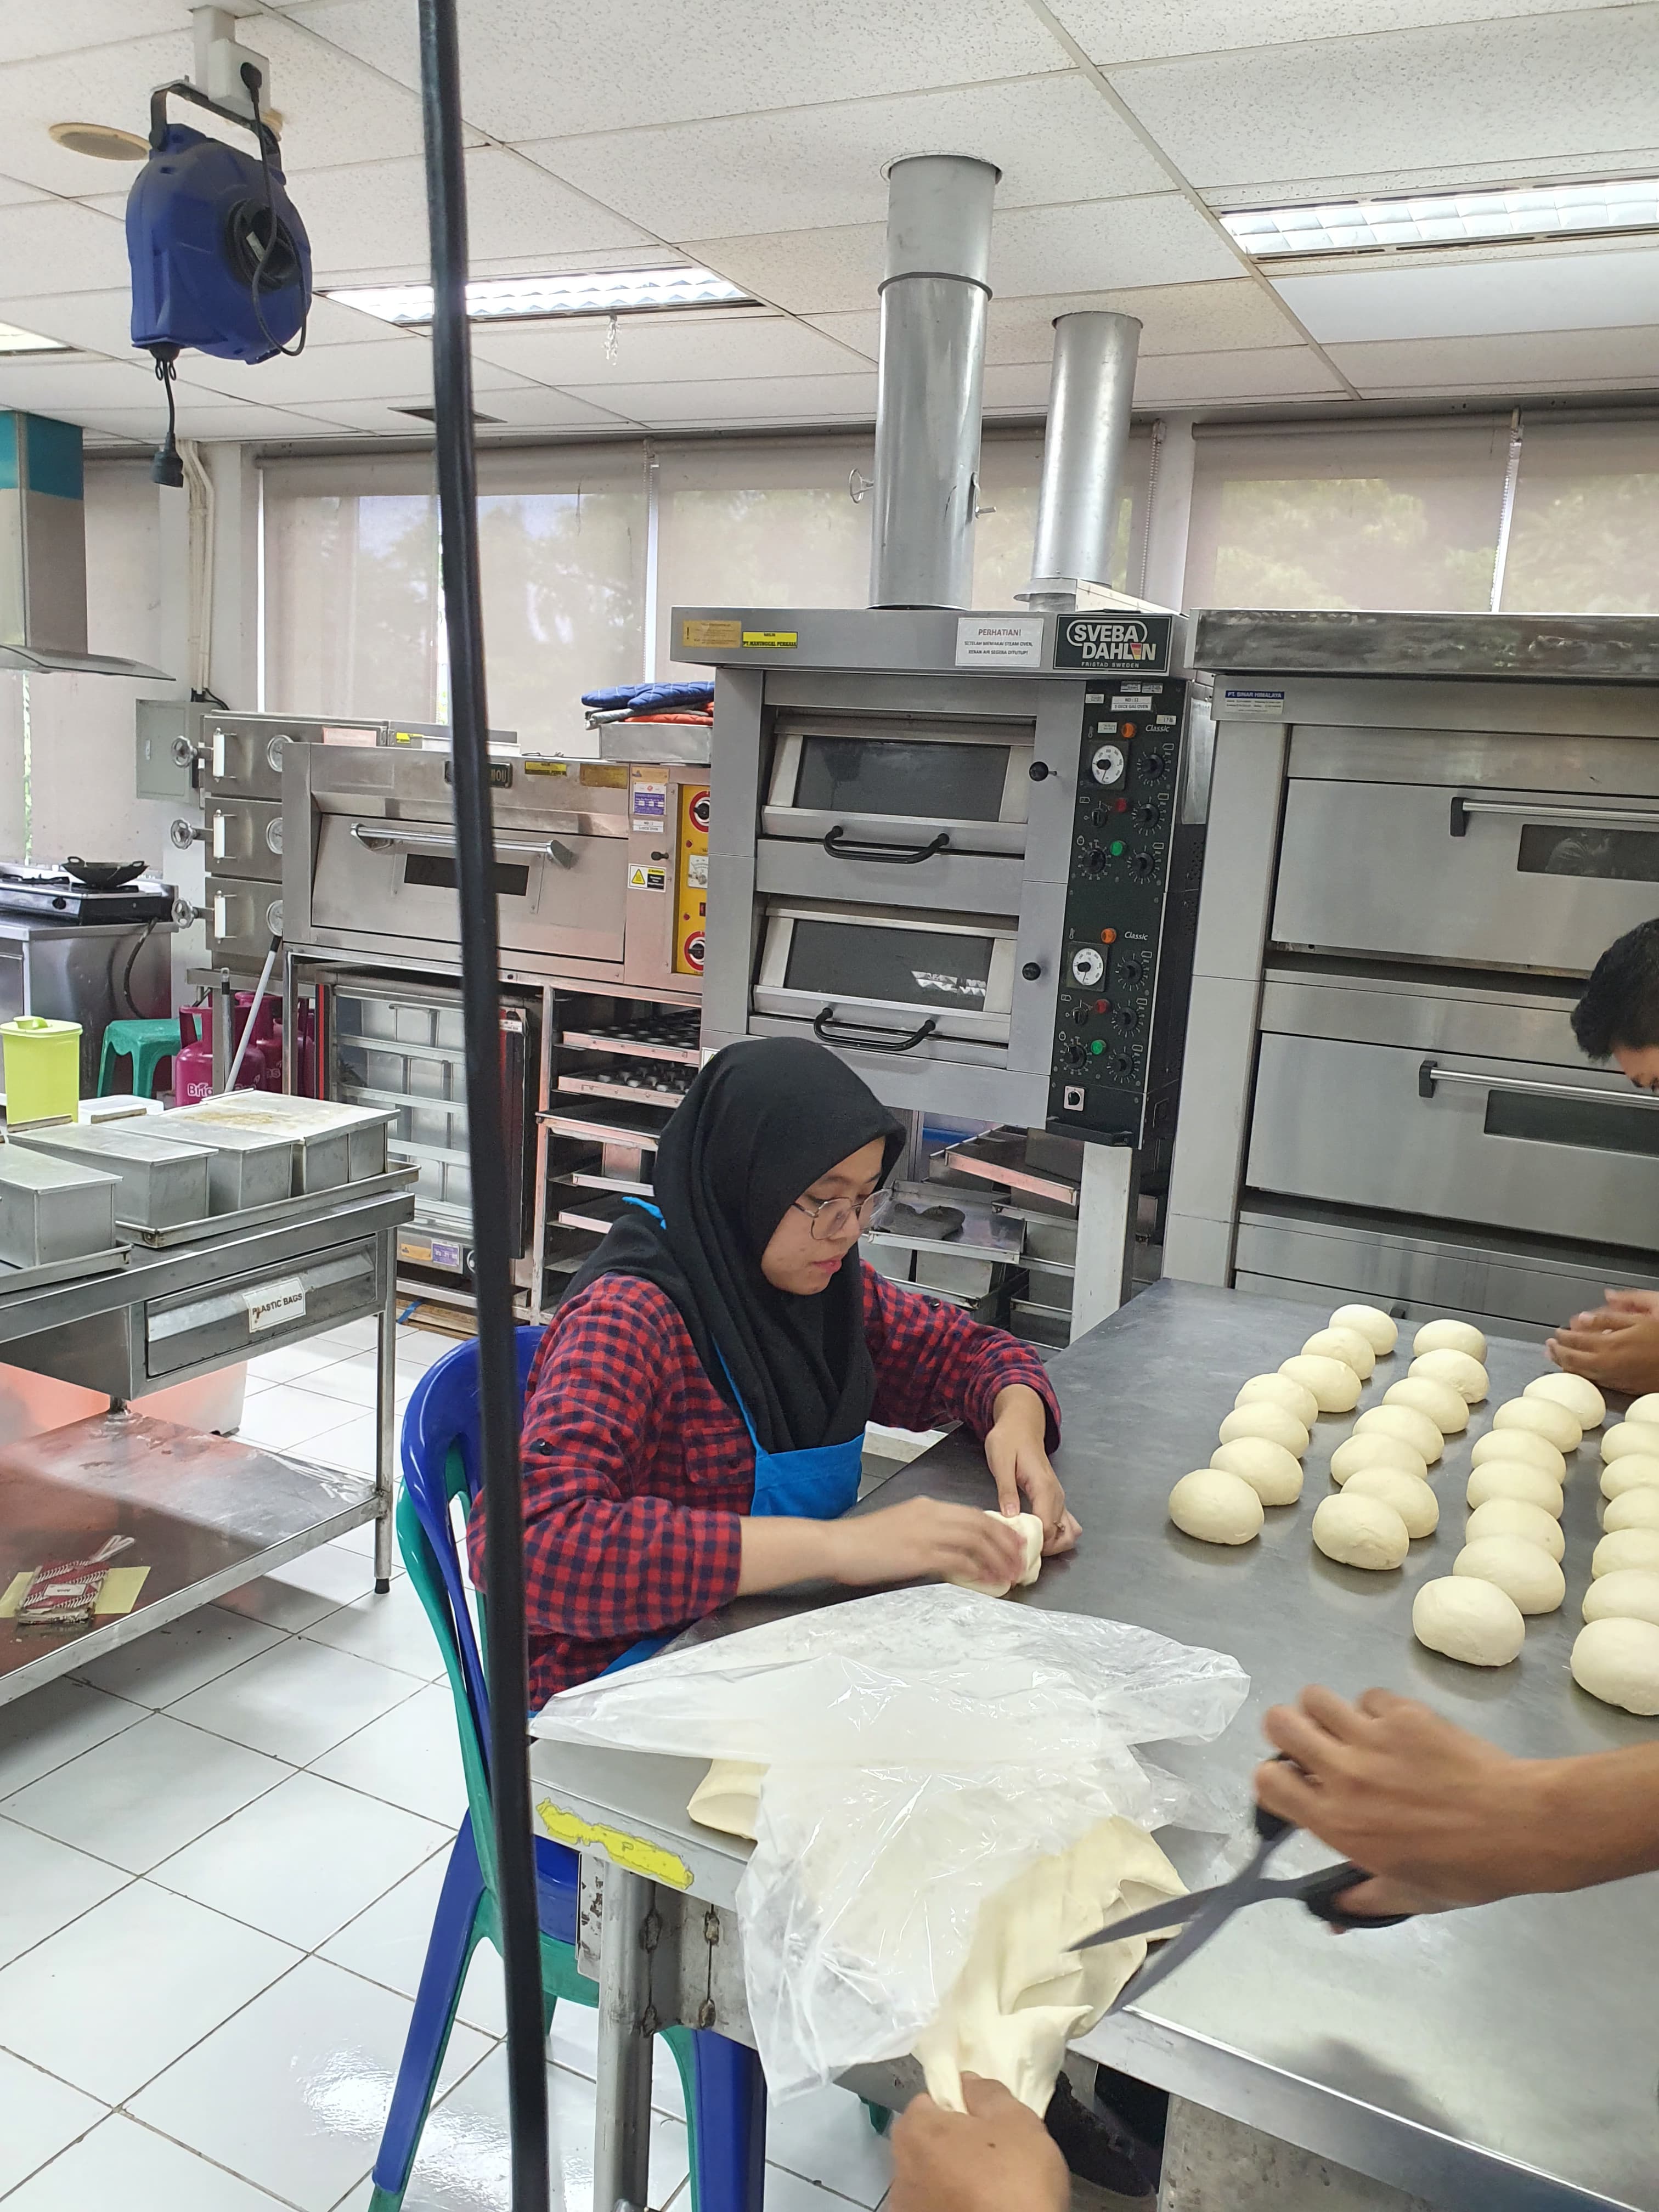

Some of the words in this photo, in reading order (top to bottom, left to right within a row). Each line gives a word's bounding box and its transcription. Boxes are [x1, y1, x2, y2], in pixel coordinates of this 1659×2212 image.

[1074, 624, 1139, 642] SVEBA
[1146, 724, 1170, 732] Classic
[1125, 931, 1148, 940] Classic
[252, 1300, 282, 1316] PLASTIC
[283, 1293, 302, 1306] BAGS
